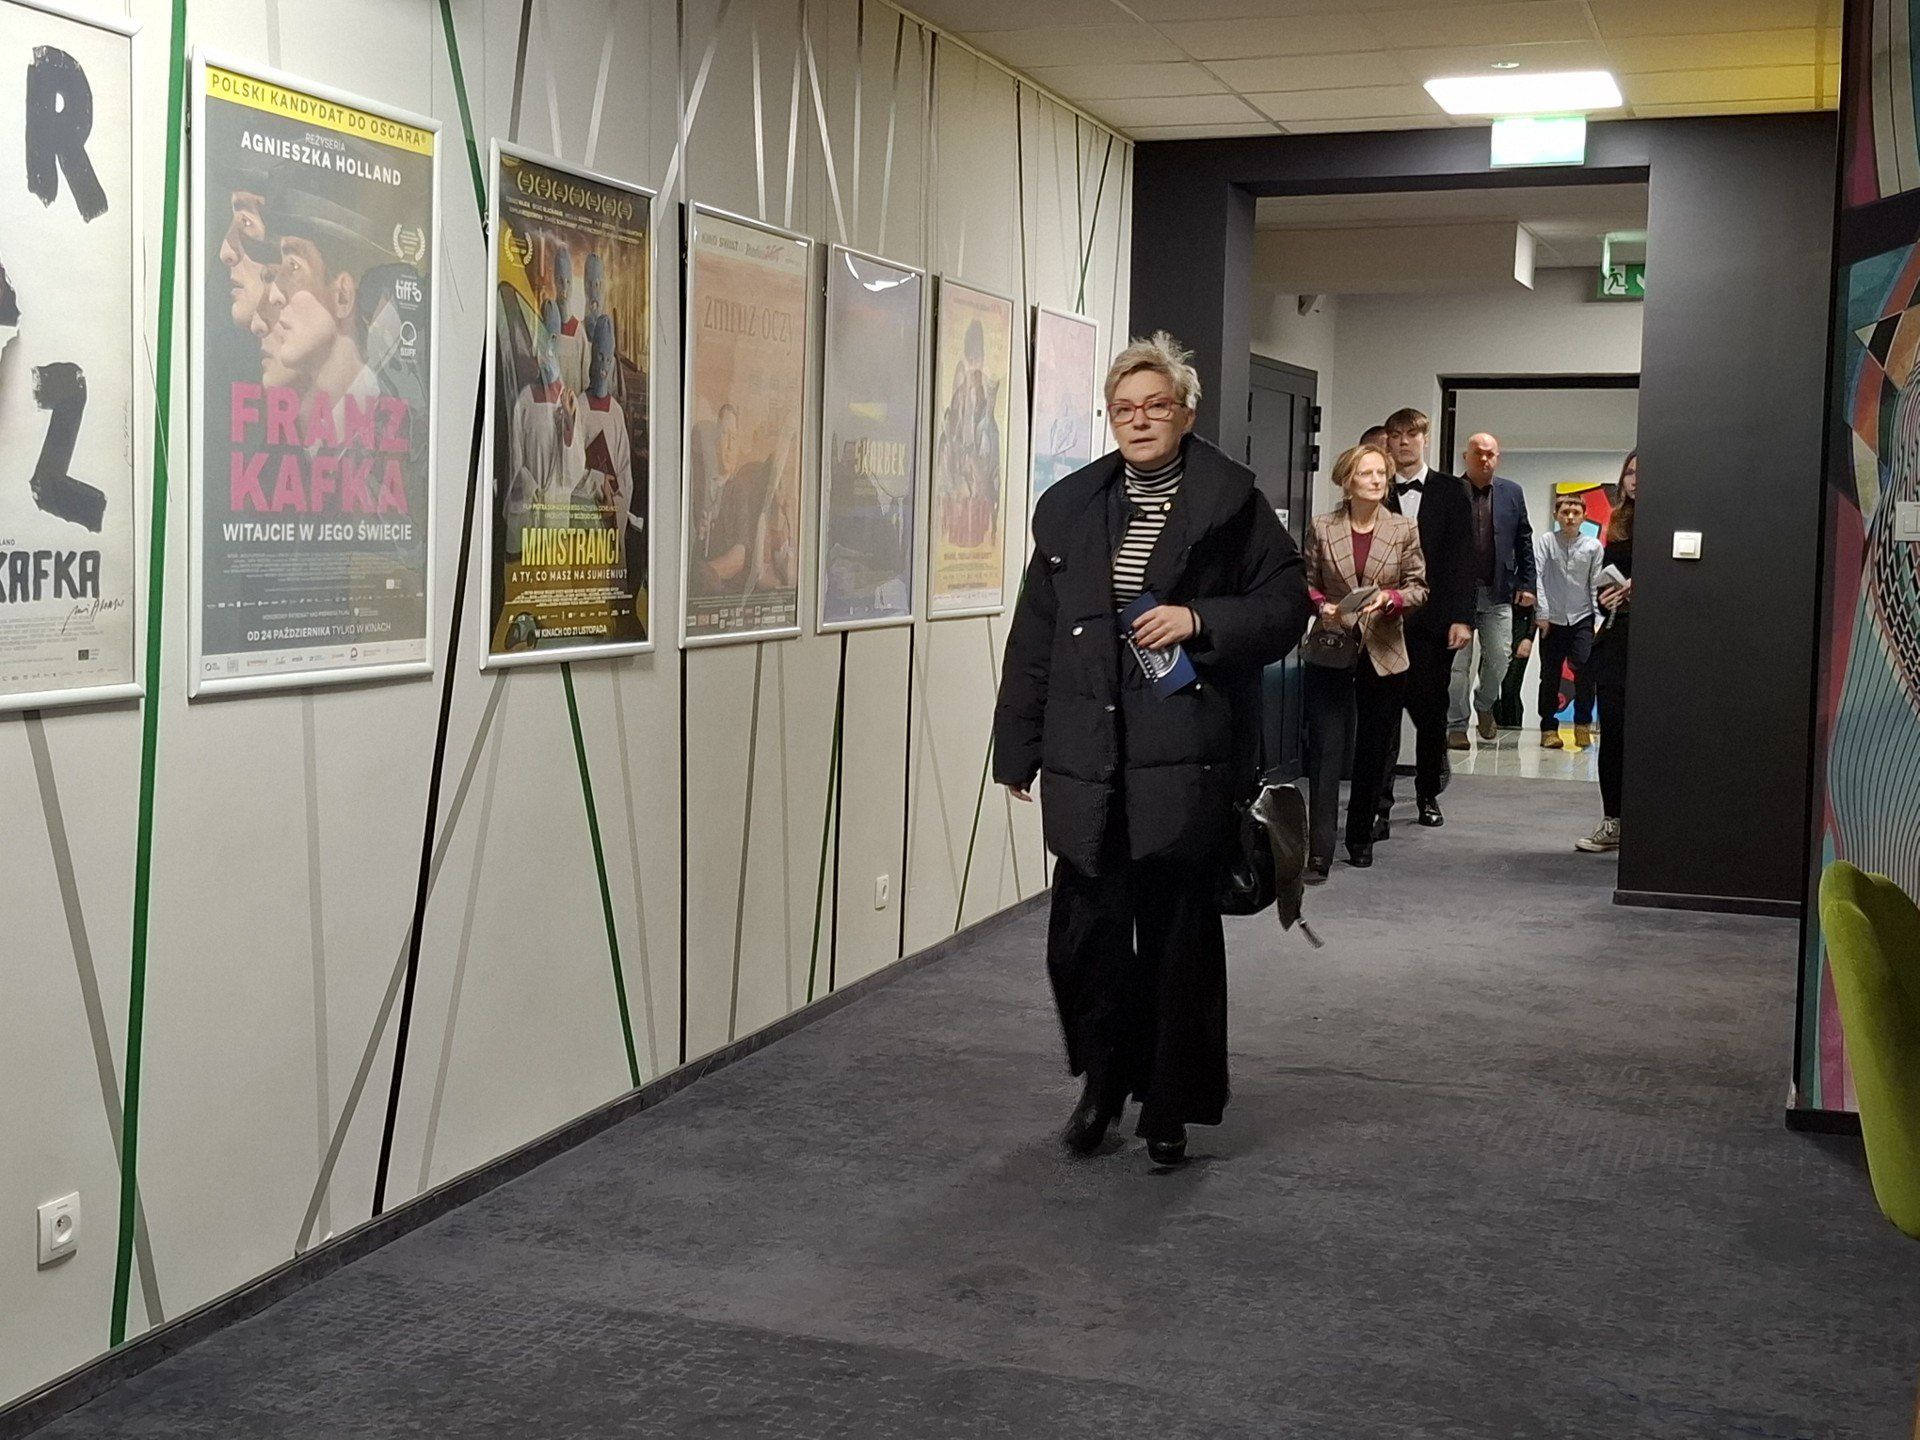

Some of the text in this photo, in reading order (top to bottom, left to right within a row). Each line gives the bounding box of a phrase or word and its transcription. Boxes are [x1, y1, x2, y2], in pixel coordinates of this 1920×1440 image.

[212, 73, 265, 102] POLSKI
[270, 93, 345, 124] KANDYDAT
[348, 114, 366, 131] DO
[241, 131, 402, 186] AGNIESZKA HOLLAND
[230, 381, 410, 453] FRANZ
[230, 451, 409, 514] KAFKA
[222, 520, 412, 542] WITAJCIE W JEGO ŚWIECIE
[521, 528, 620, 566] MINISTRANCI
[511, 568, 628, 584] A TY, CO MASZ NA SUMIENIU?
[247, 622, 392, 642] OD 24 PAŹDZIERNIKA TYLKO W KINACH
[534, 628, 541, 638] W
[541, 626, 563, 638] KINACH
[563, 626, 572, 636] OD
[578, 624, 608, 635] LISTOPADA
